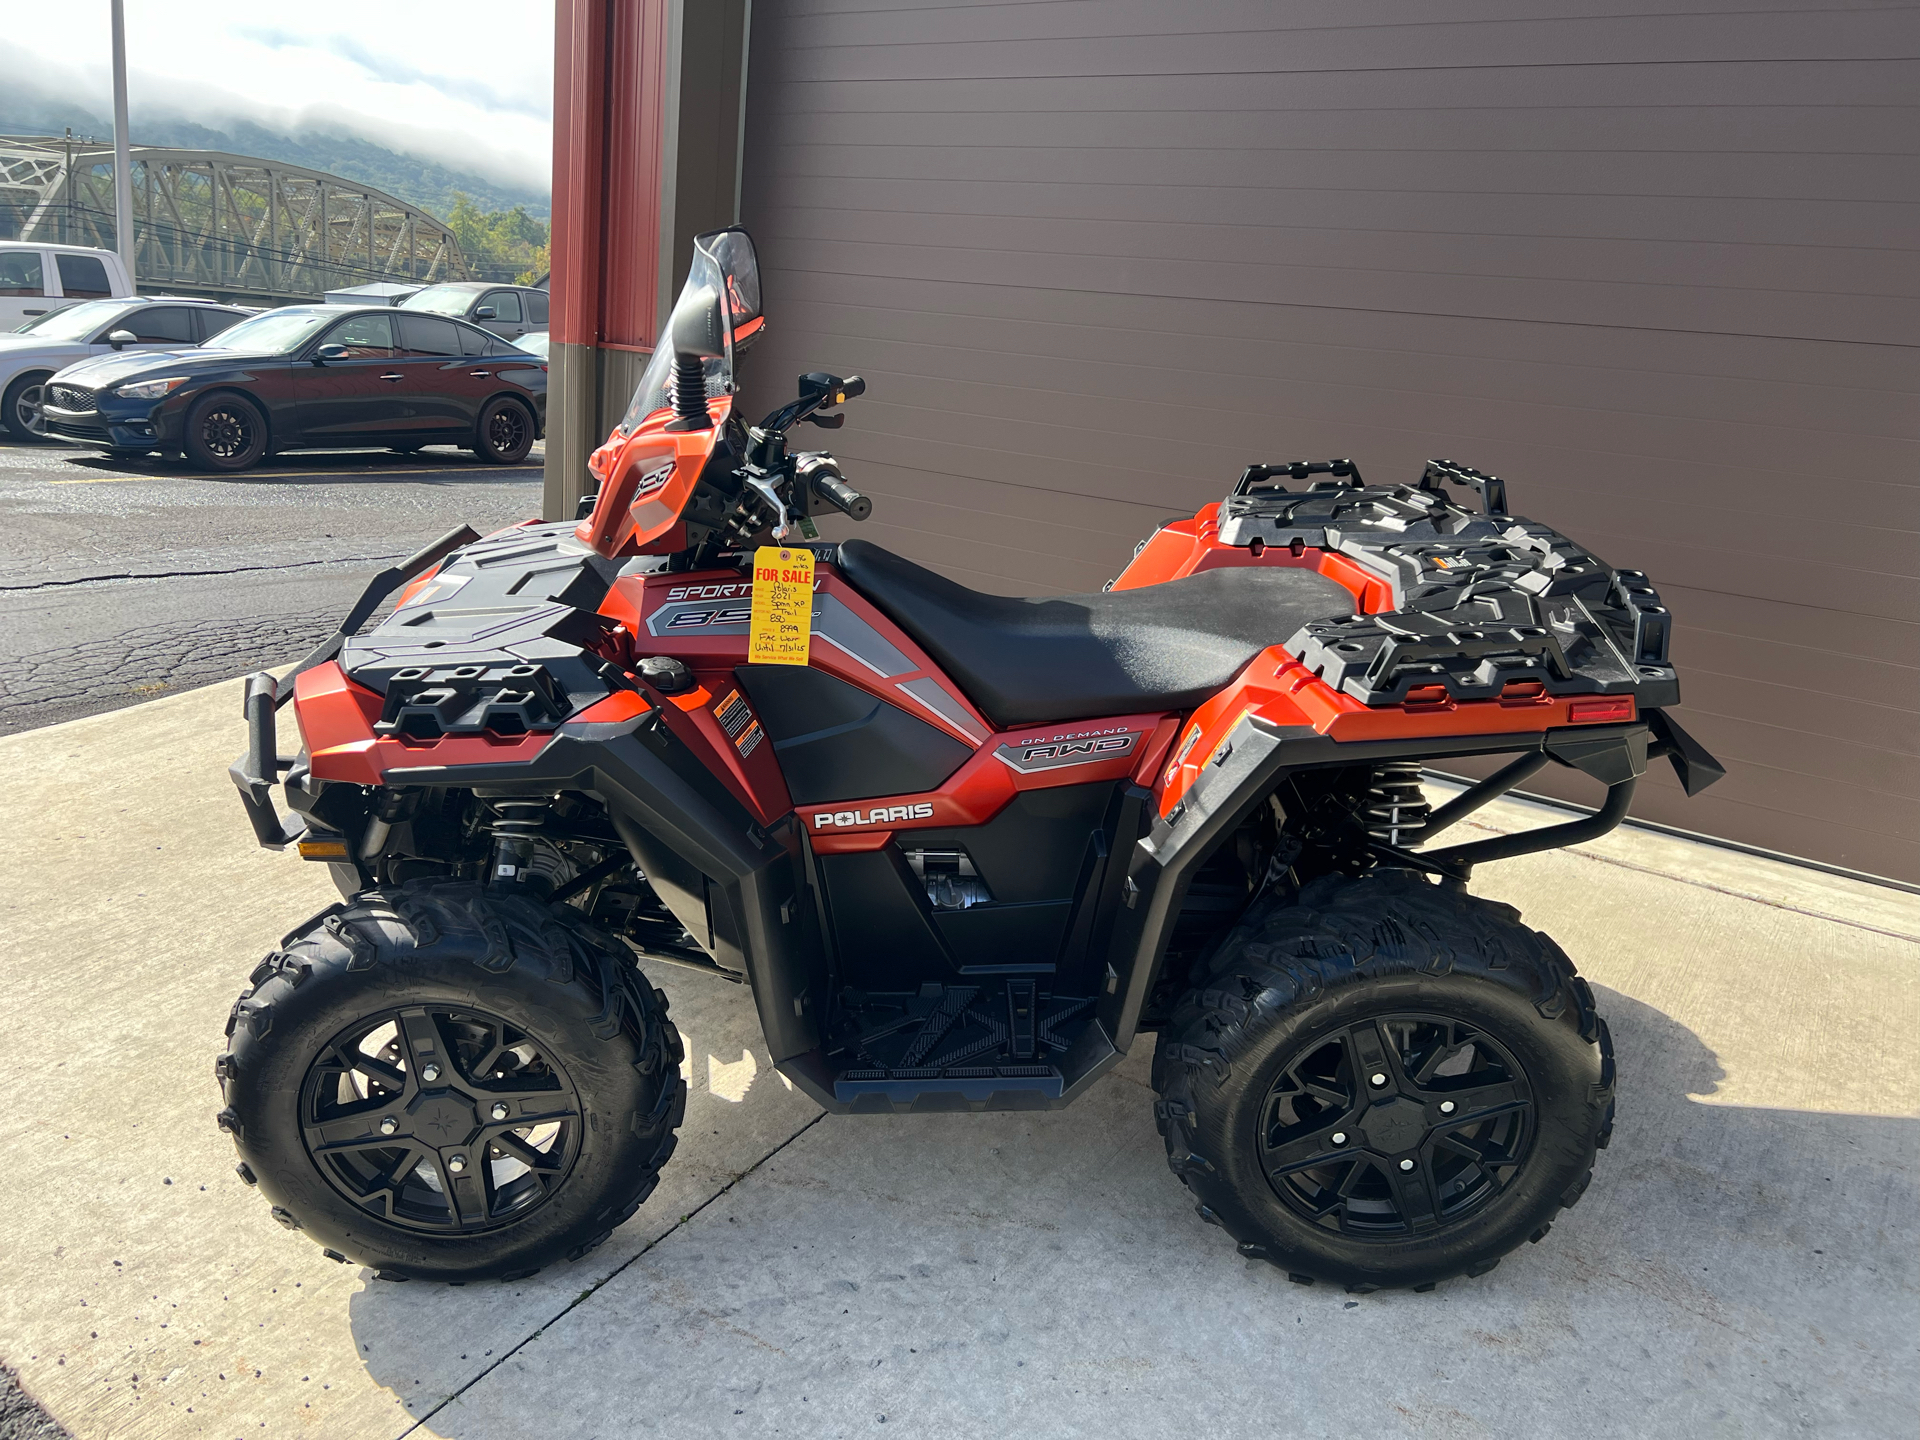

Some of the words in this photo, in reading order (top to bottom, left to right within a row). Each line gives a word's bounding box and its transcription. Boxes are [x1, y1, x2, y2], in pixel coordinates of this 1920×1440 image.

[756, 568, 778, 582] FOR
[782, 569, 811, 584] SALE
[770, 590, 791, 600] 2021
[773, 581, 797, 592] Polaris
[665, 607, 753, 629] 85
[1021, 737, 1046, 745] ON
[1053, 727, 1128, 741] DEMAND
[1022, 736, 1132, 762] AWD
[814, 802, 934, 829] POLARIS
